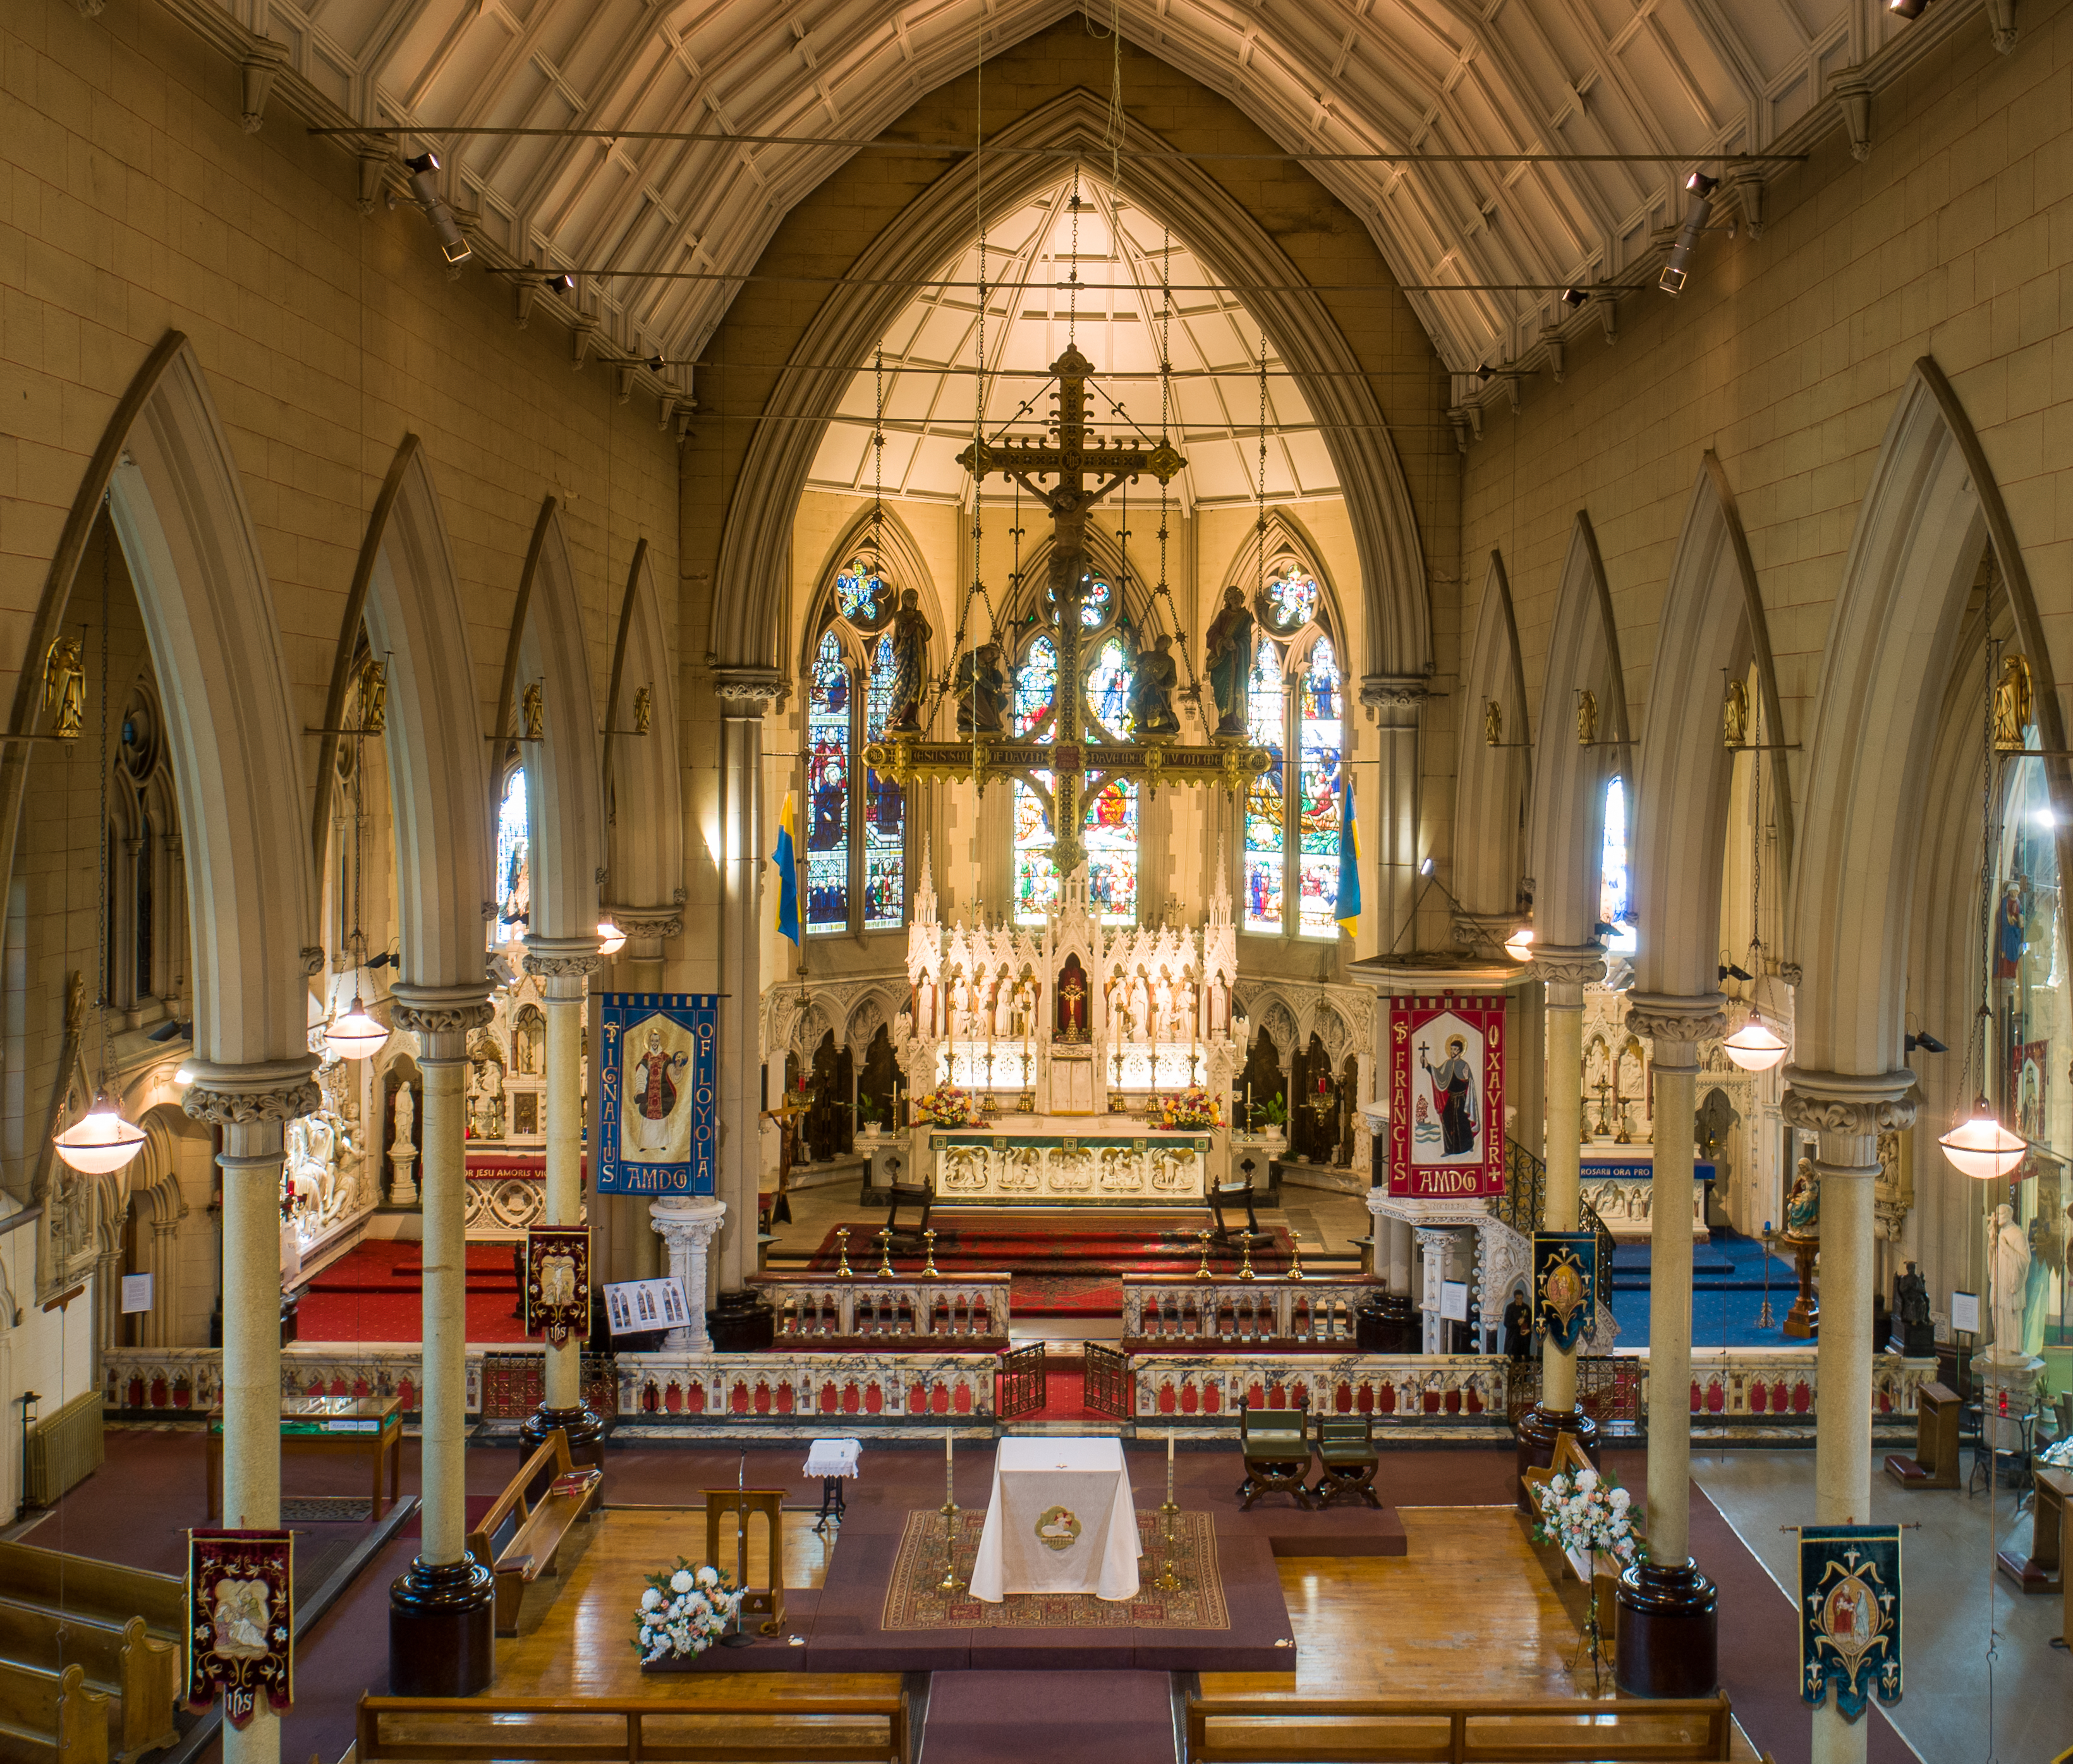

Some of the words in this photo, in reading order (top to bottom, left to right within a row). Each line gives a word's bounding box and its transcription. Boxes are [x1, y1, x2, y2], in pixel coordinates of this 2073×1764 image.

[914, 750, 947, 762] JESUS
[949, 750, 972, 762] SON
[990, 751, 1004, 762] OF
[1005, 751, 1043, 763] DAVID
[1183, 753, 1200, 765] ON
[1203, 753, 1222, 766] ME
[698, 1023, 714, 1057] OF
[602, 1049, 618, 1183] IGNATIUS
[1392, 1052, 1407, 1181] FRANCIS
[1486, 1052, 1502, 1164] XAVIER
[695, 1068, 712, 1178] LOYOLA
[475, 1169, 494, 1177] JESU
[627, 1168, 688, 1190] AMDG
[1419, 1171, 1476, 1193] AMDG
[1613, 1168, 1631, 1176] ORA
